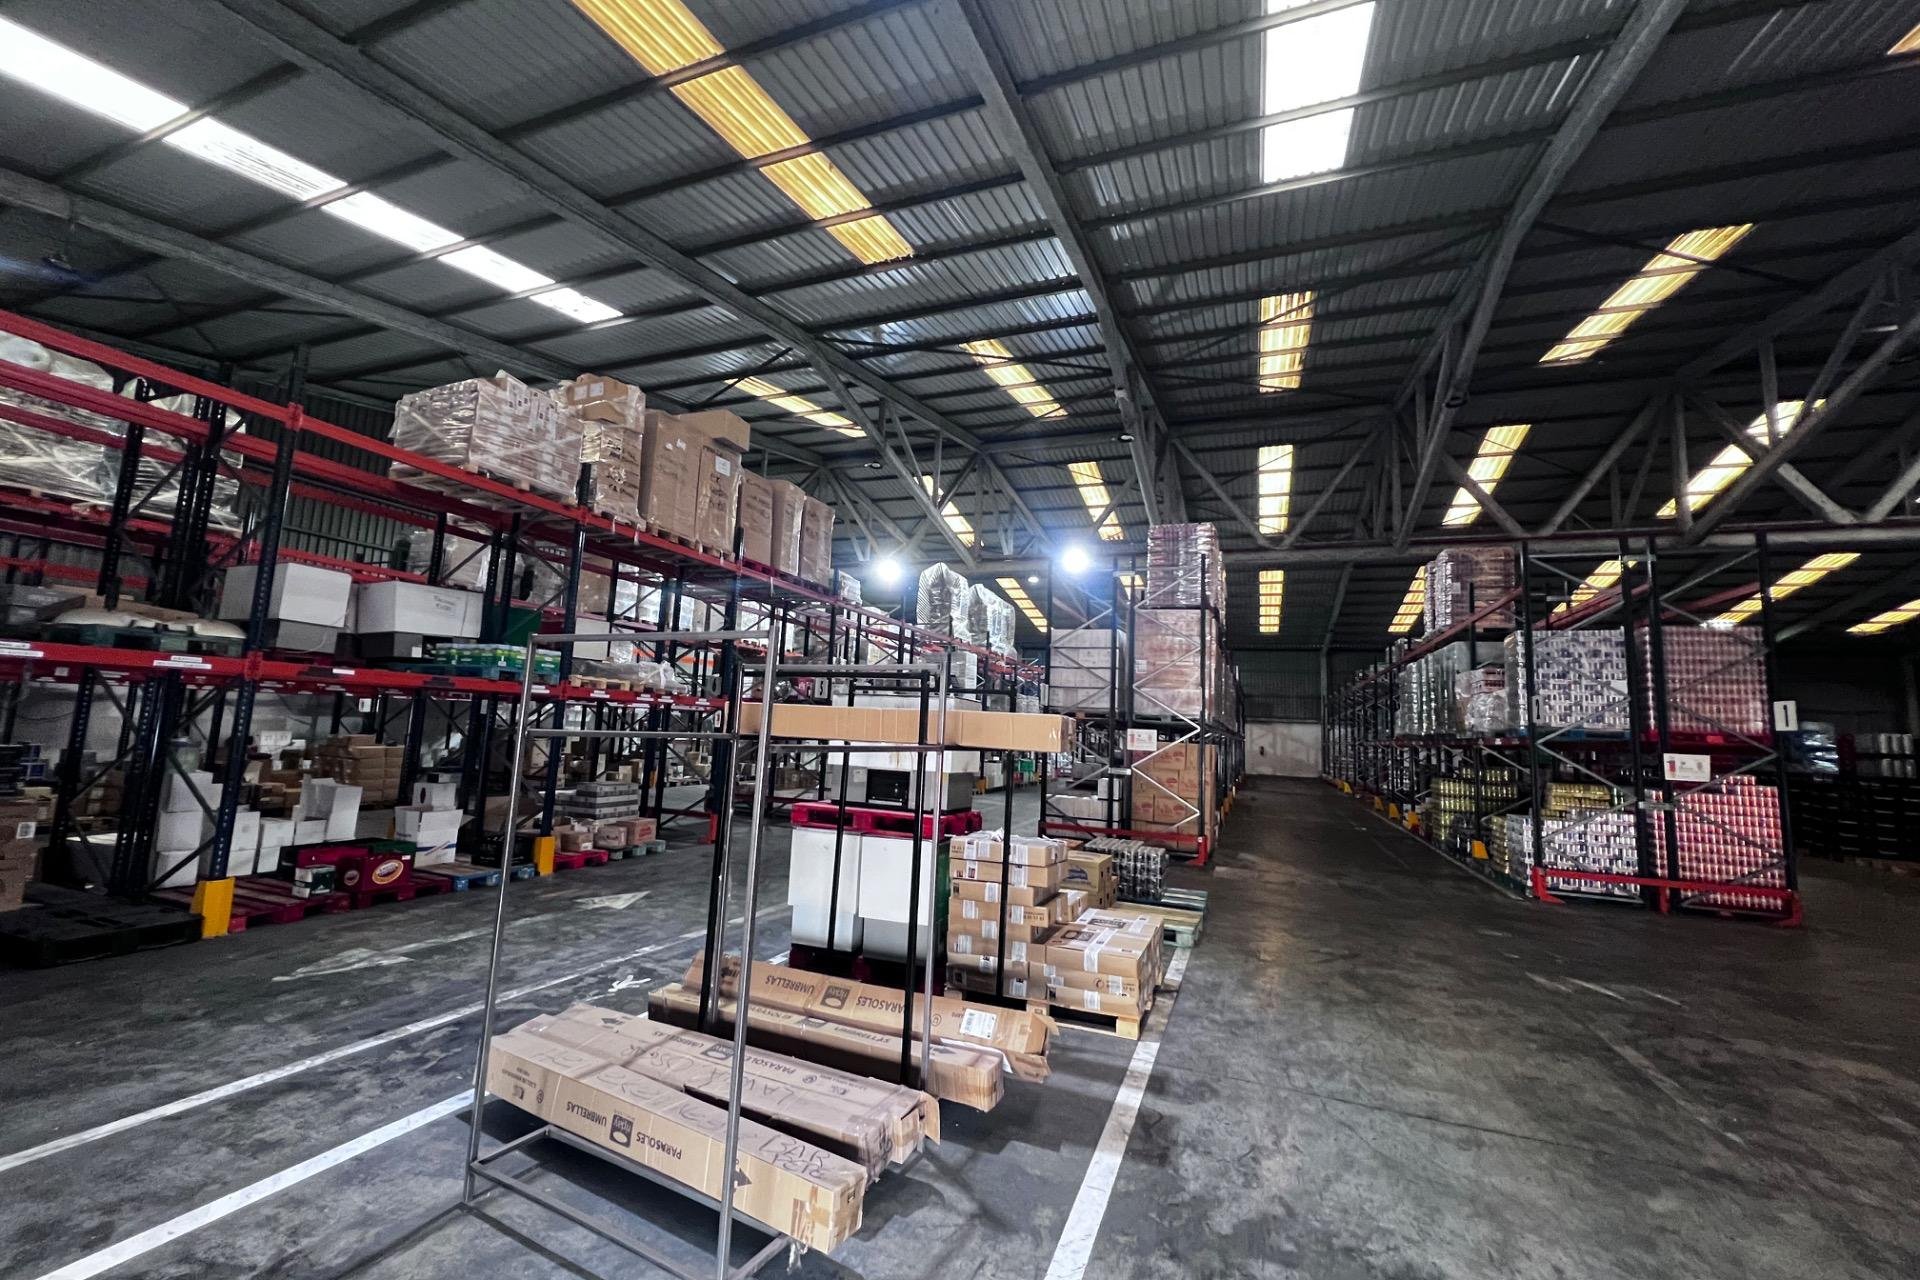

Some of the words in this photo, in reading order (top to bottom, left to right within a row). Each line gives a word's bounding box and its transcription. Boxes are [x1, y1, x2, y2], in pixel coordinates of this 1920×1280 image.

[1782, 704, 1790, 728] 1
[765, 975, 815, 995] UMBRELLAS
[566, 1101, 607, 1127] UMBRELLAS
[636, 1131, 682, 1160] PARASOLES
